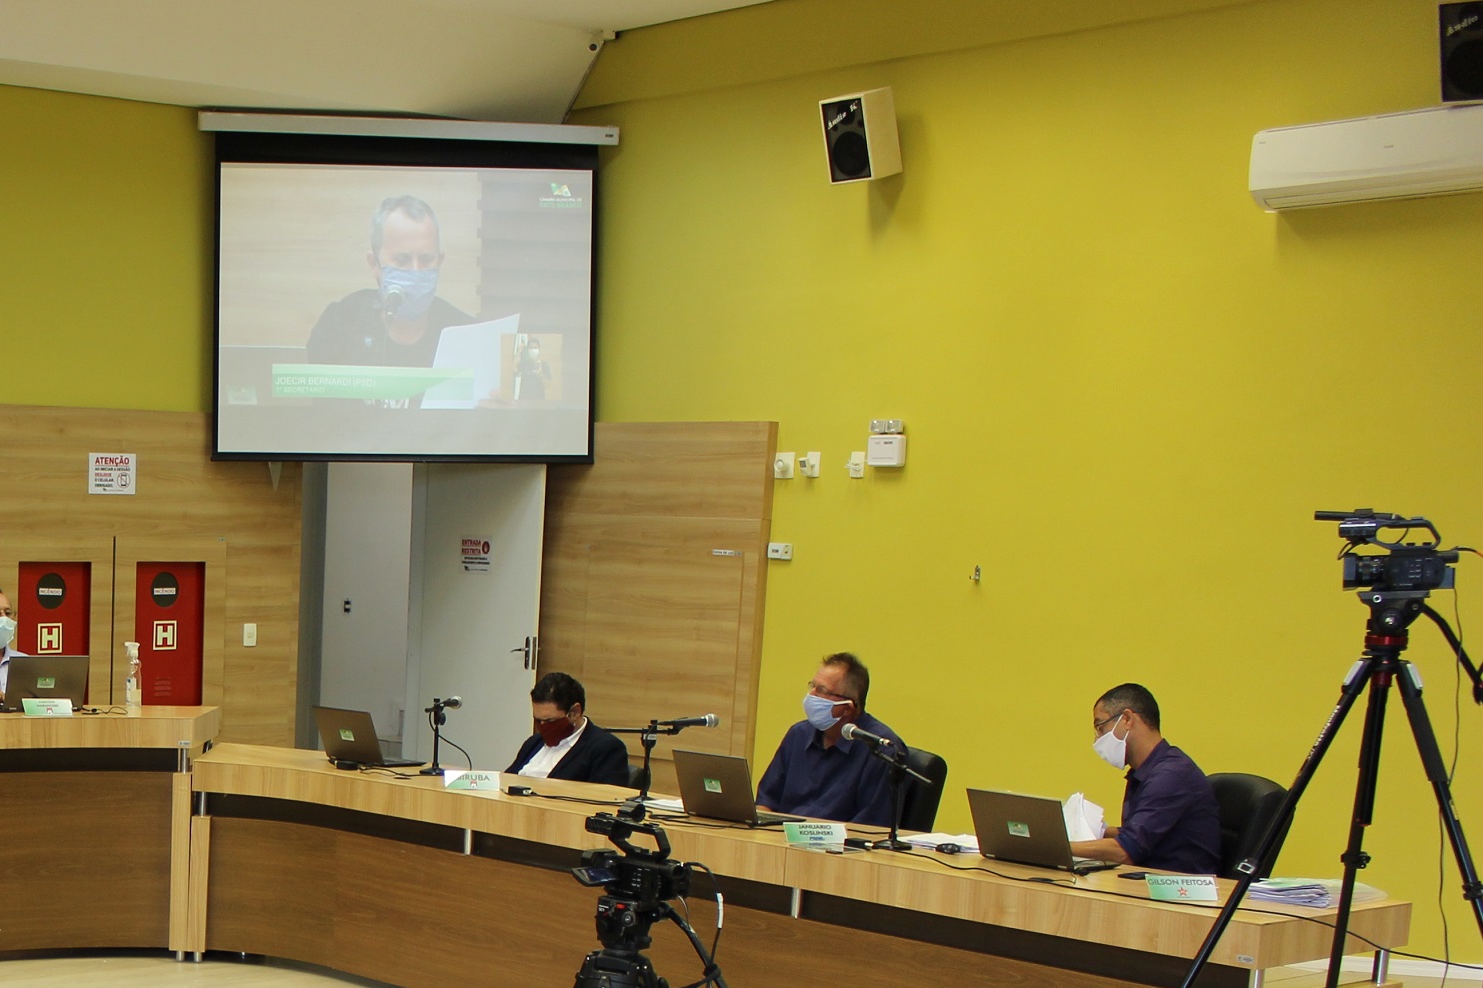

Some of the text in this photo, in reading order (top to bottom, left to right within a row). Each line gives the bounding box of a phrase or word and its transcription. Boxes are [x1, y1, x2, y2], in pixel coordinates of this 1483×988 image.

[828, 112, 846, 130] Audio
[276, 376, 306, 386] JOECIR
[309, 377, 351, 386] BERNARDI
[95, 455, 129, 466] ATENÇÃO
[42, 628, 58, 648] H
[157, 625, 173, 645] H
[1148, 878, 1214, 886] GILSON FEITOSA
